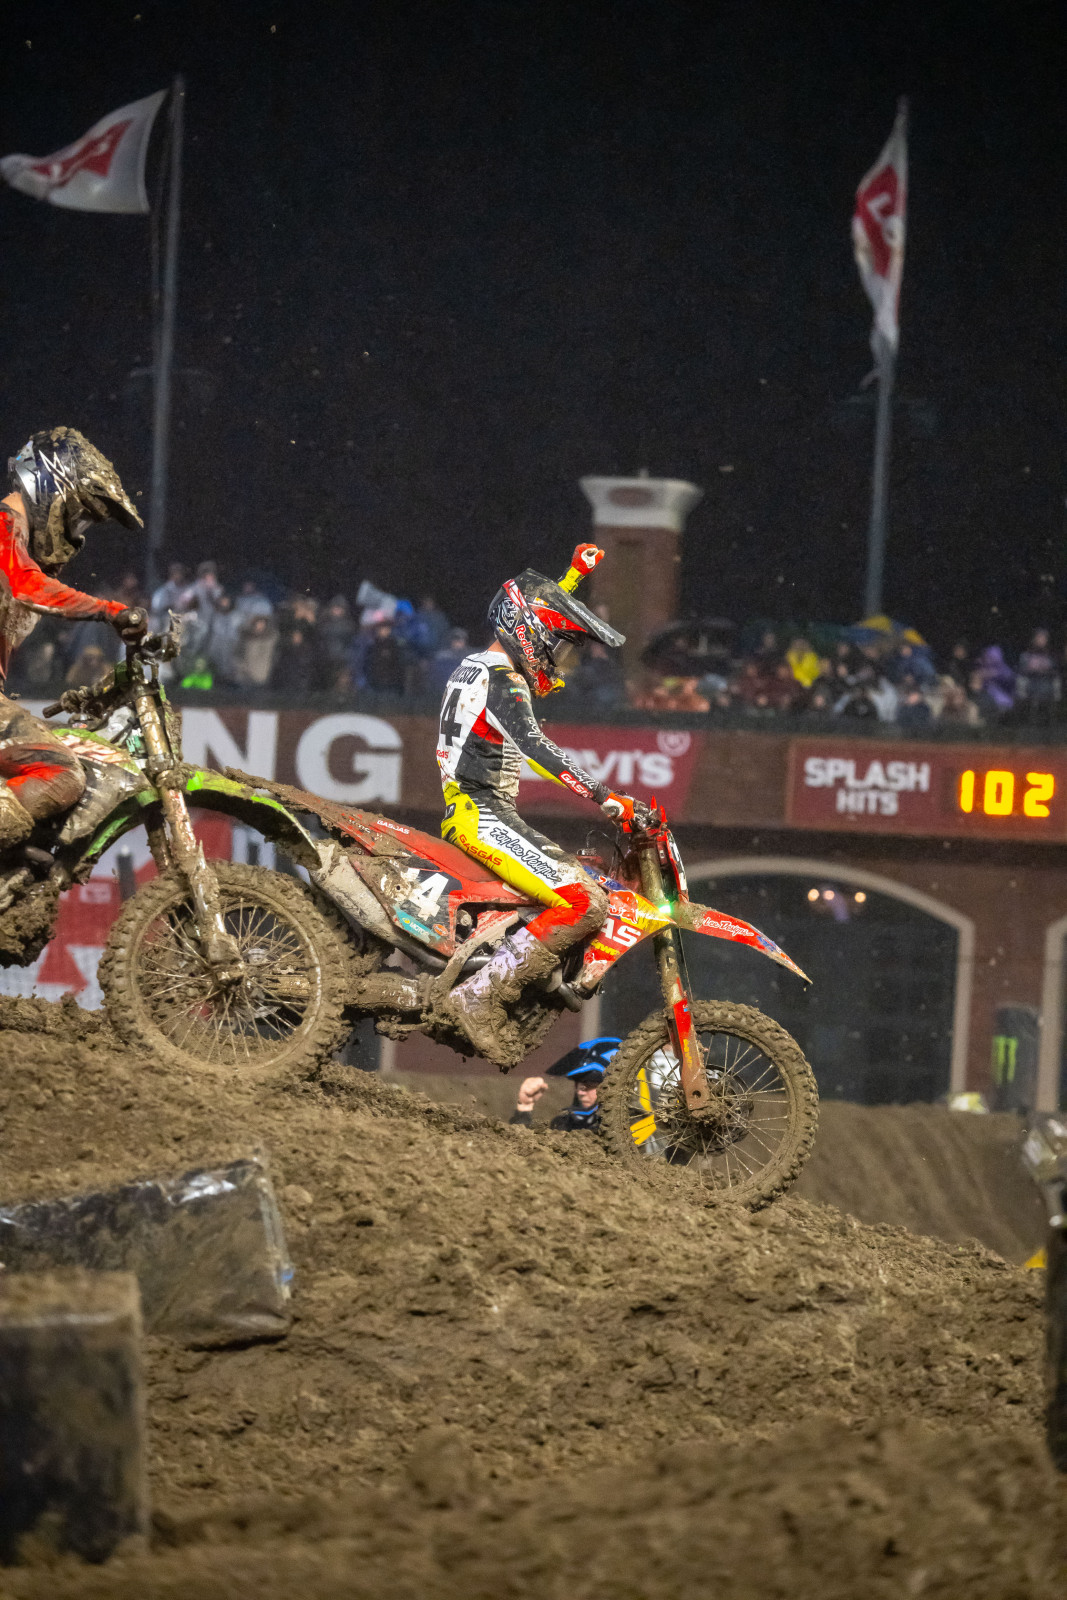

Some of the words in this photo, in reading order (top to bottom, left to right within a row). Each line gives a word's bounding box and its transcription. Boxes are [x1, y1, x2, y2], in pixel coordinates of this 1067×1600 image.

[440, 687, 462, 746] 4
[804, 757, 930, 792] SPLASH
[835, 789, 899, 816] HITS
[960, 769, 1055, 817] 102
[459, 834, 503, 866] GASGAS
